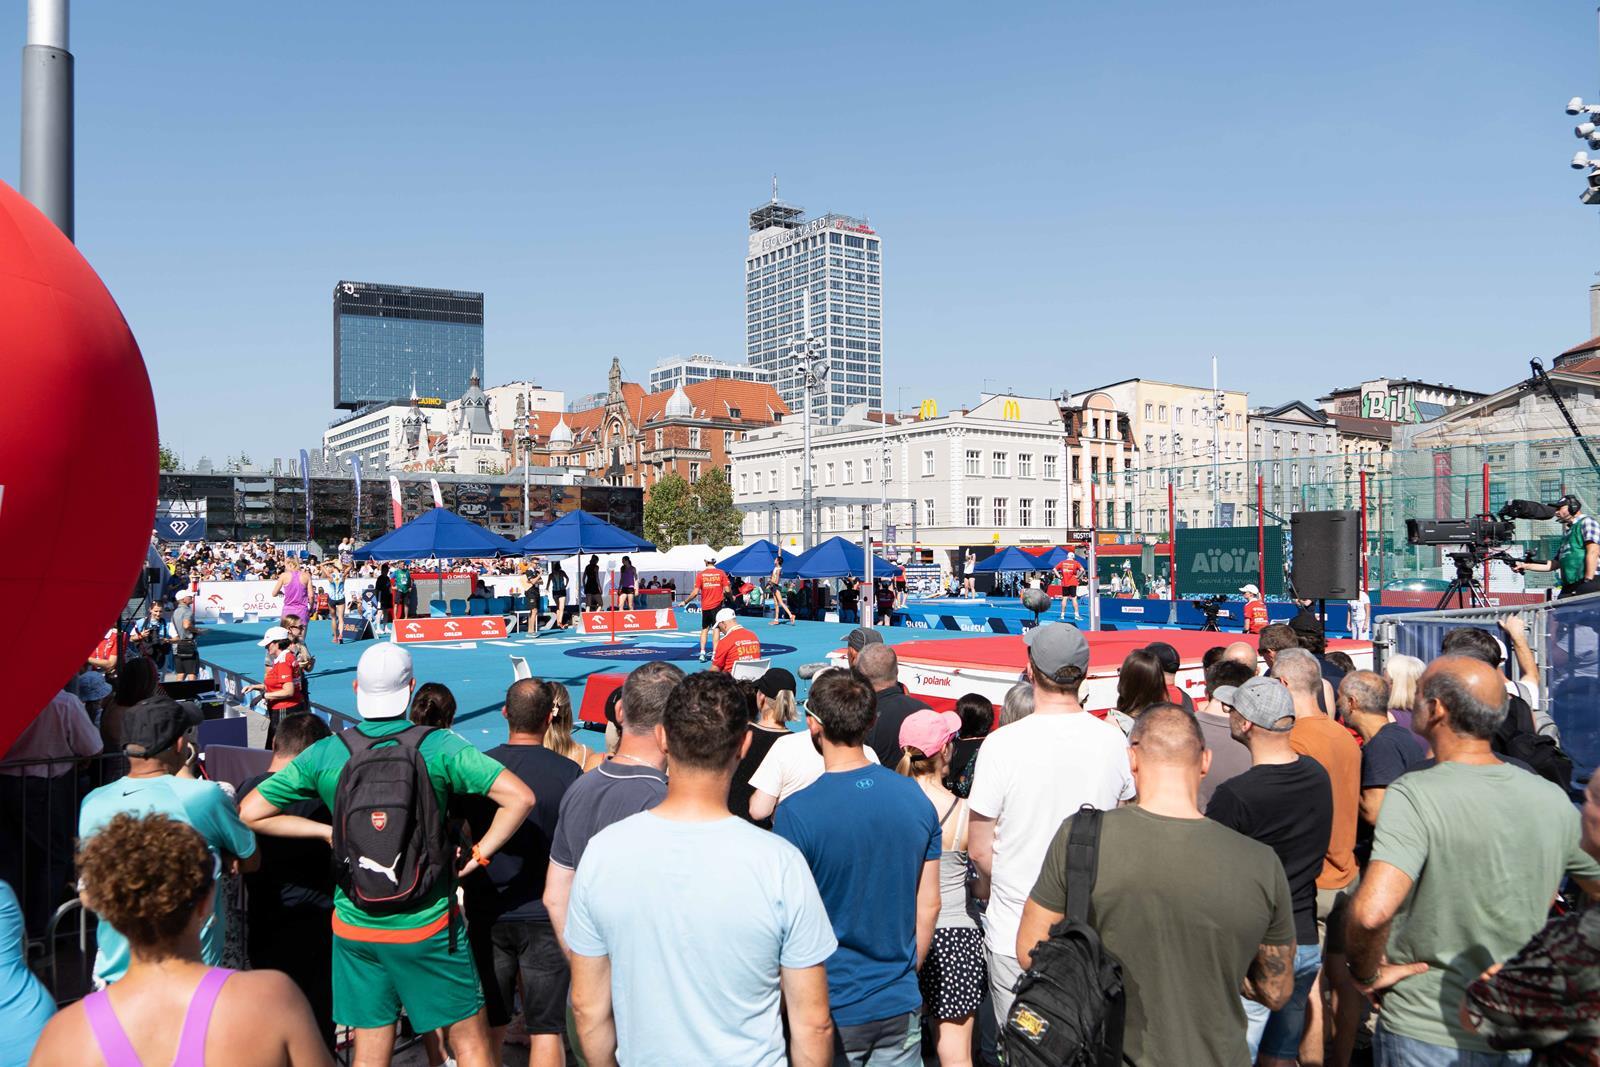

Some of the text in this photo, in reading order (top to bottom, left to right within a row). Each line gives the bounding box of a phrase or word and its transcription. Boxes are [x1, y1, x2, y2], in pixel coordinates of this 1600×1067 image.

[762, 217, 826, 250] COURTYARD
[243, 602, 277, 610] OMEGA
[905, 620, 928, 629] SILESIA
[960, 623, 986, 633] SILESIA
[922, 674, 951, 687] polanik
